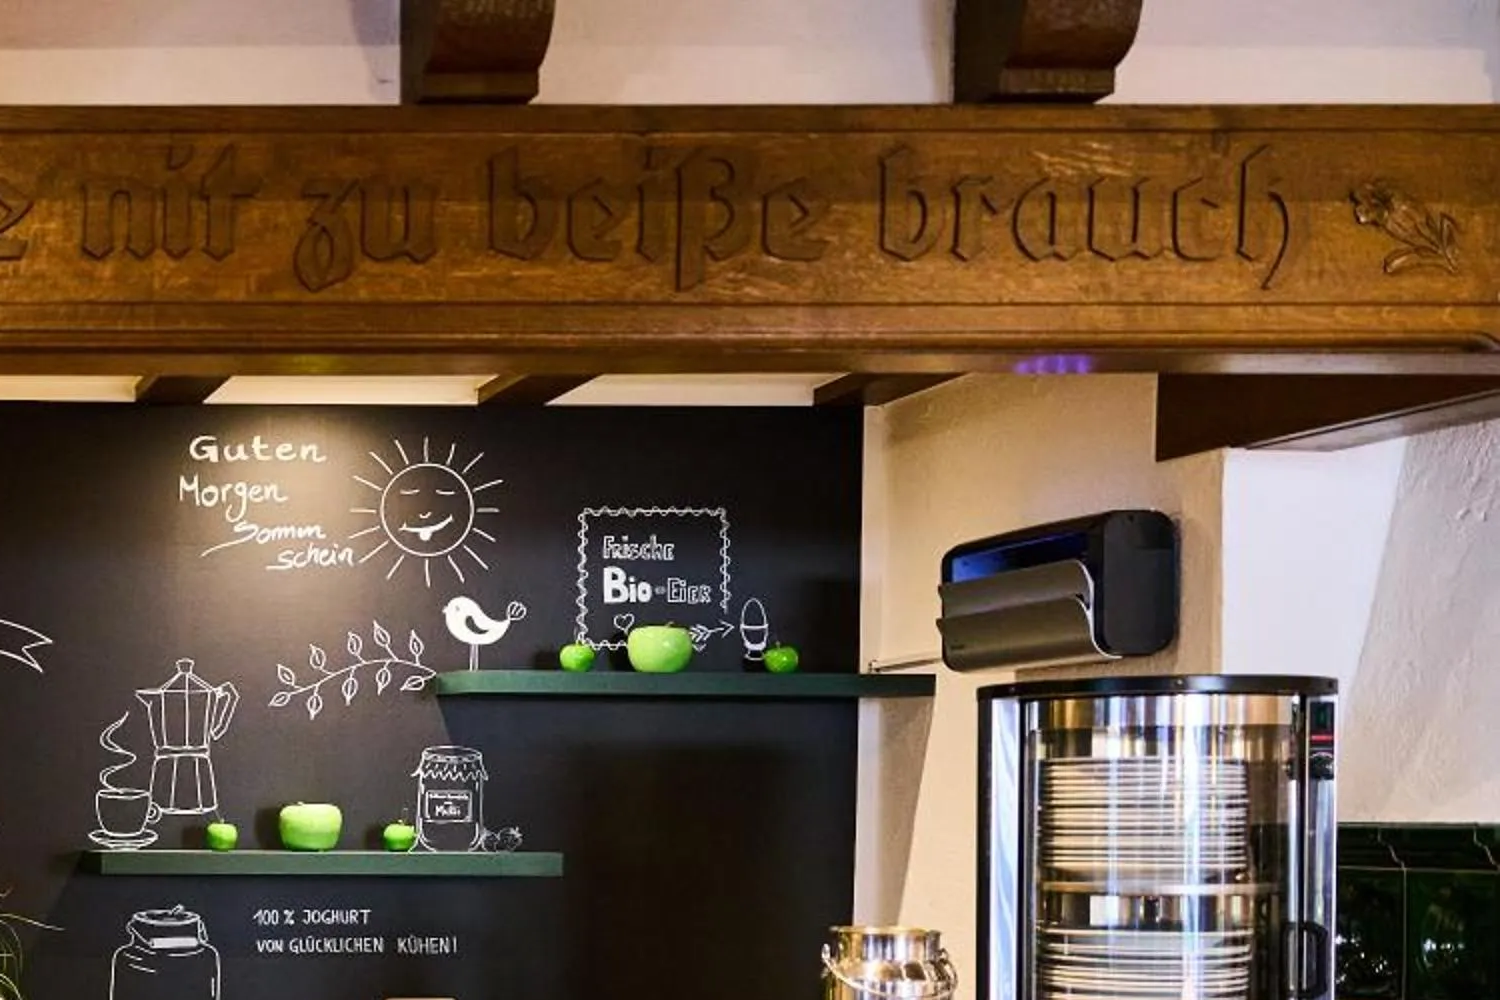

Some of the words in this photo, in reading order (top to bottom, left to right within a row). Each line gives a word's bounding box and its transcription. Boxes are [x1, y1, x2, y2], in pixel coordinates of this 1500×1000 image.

[78, 143, 264, 260] nit
[293, 174, 440, 292] zu
[878, 142, 1290, 290] brauch
[189, 435, 327, 462] Guten
[179, 474, 288, 522] Morgen
[266, 542, 354, 571] schein
[603, 533, 675, 561] Frische
[253, 908, 279, 926] 100
[302, 908, 372, 925] JOGHURT
[256, 938, 284, 953] VON
[289, 935, 384, 954] GLÜCKLICHEN
[397, 934, 458, 955] KÜHEN!
